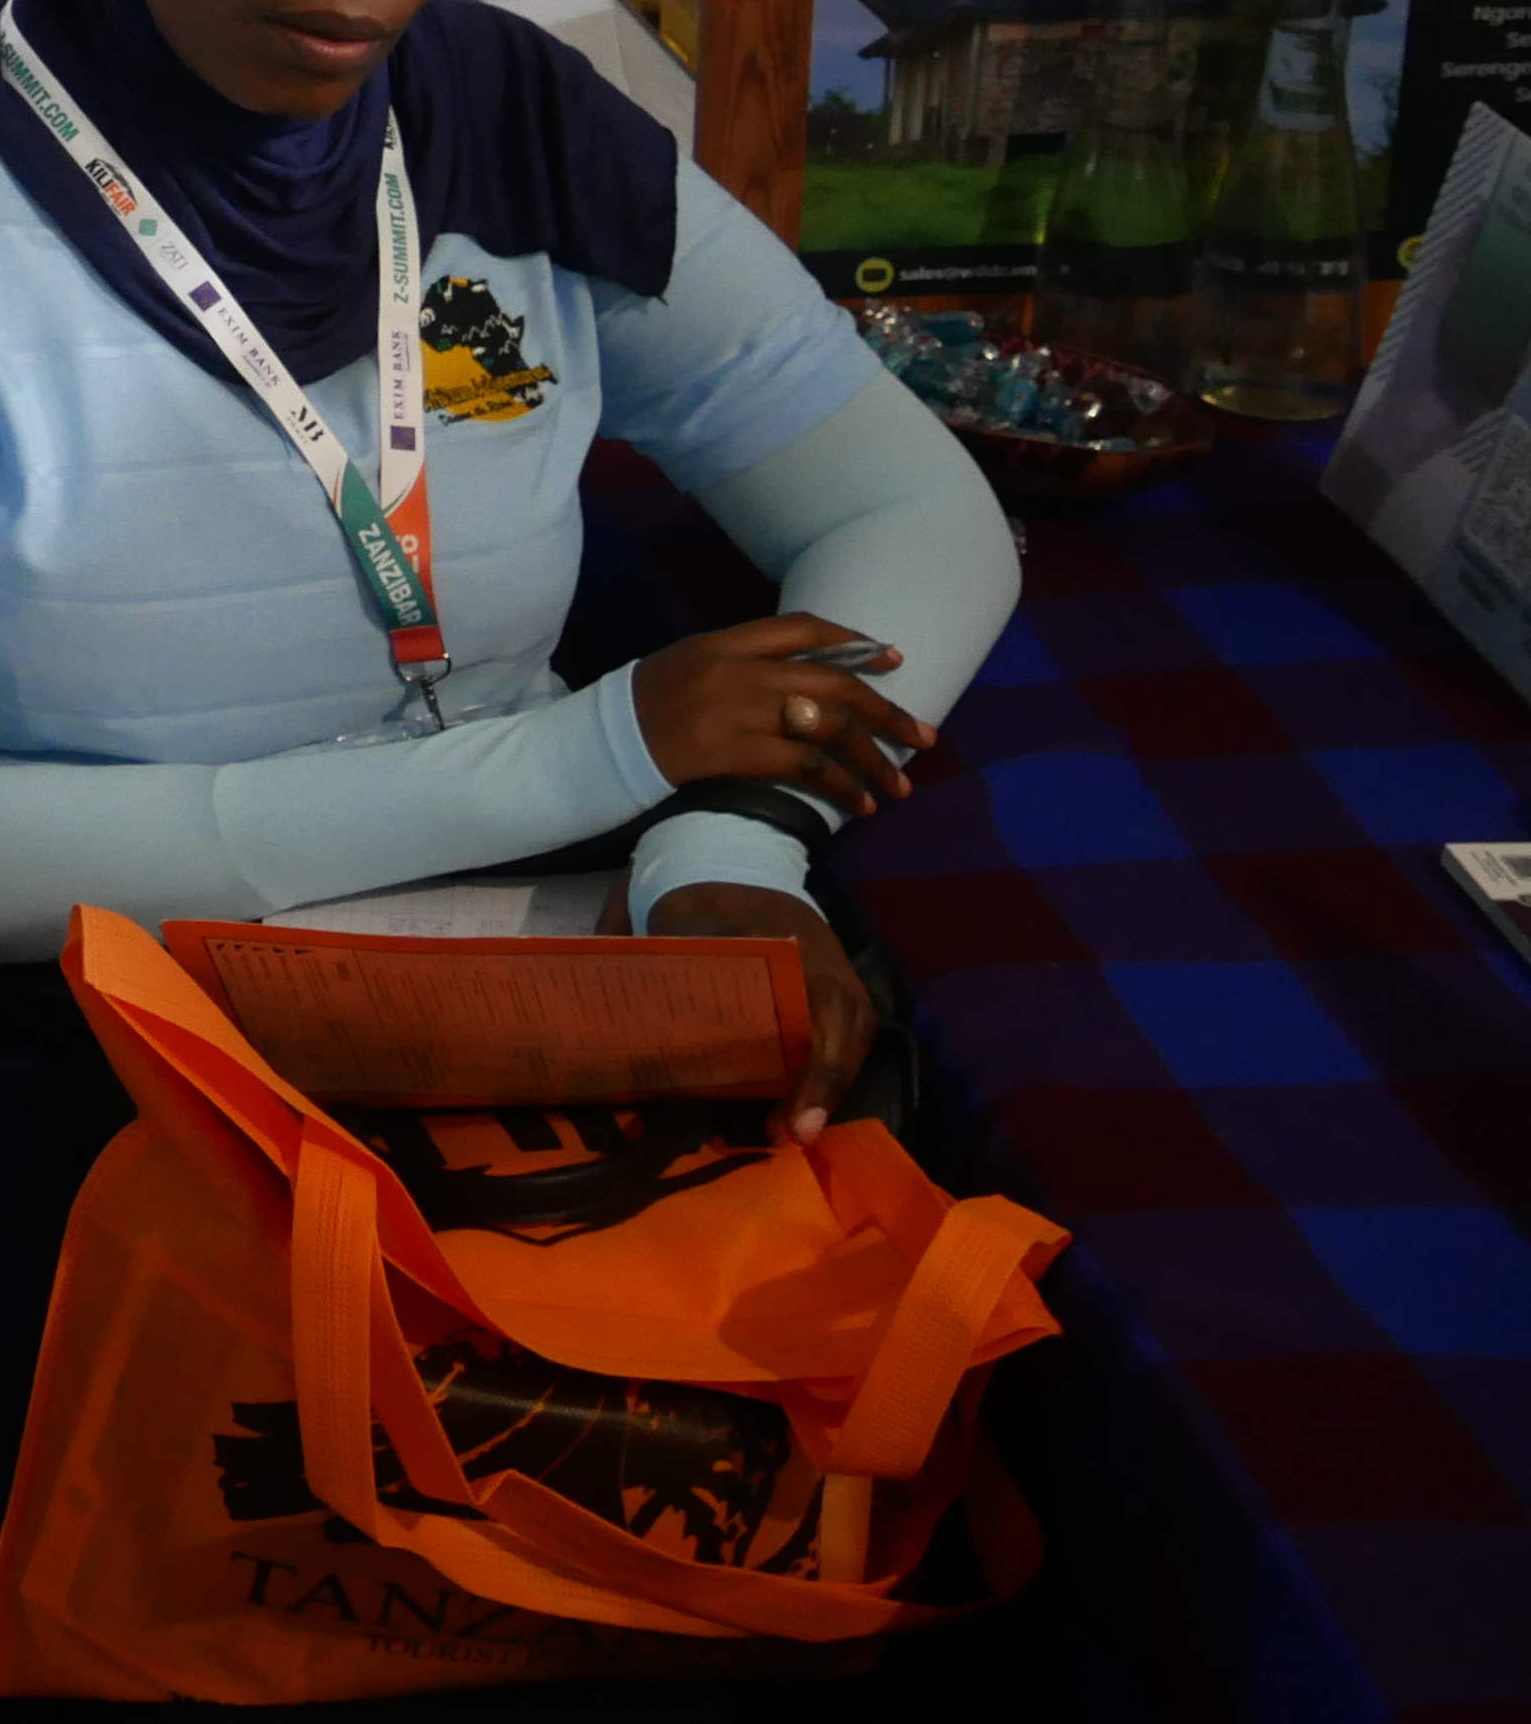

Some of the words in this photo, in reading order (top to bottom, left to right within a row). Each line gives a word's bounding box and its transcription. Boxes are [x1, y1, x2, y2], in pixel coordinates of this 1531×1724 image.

[84, 157, 138, 217] KILIFAIR
[386, 171, 410, 306] Z-SUMMIT.COM
[216, 306, 249, 346] EXIM
[248, 346, 282, 387] BANK
[391, 330, 404, 372] BANK
[392, 380, 405, 420] EXIM
[357, 522, 423, 628] ZANZIBAR
[368, 1635, 516, 1666] TOURIST
